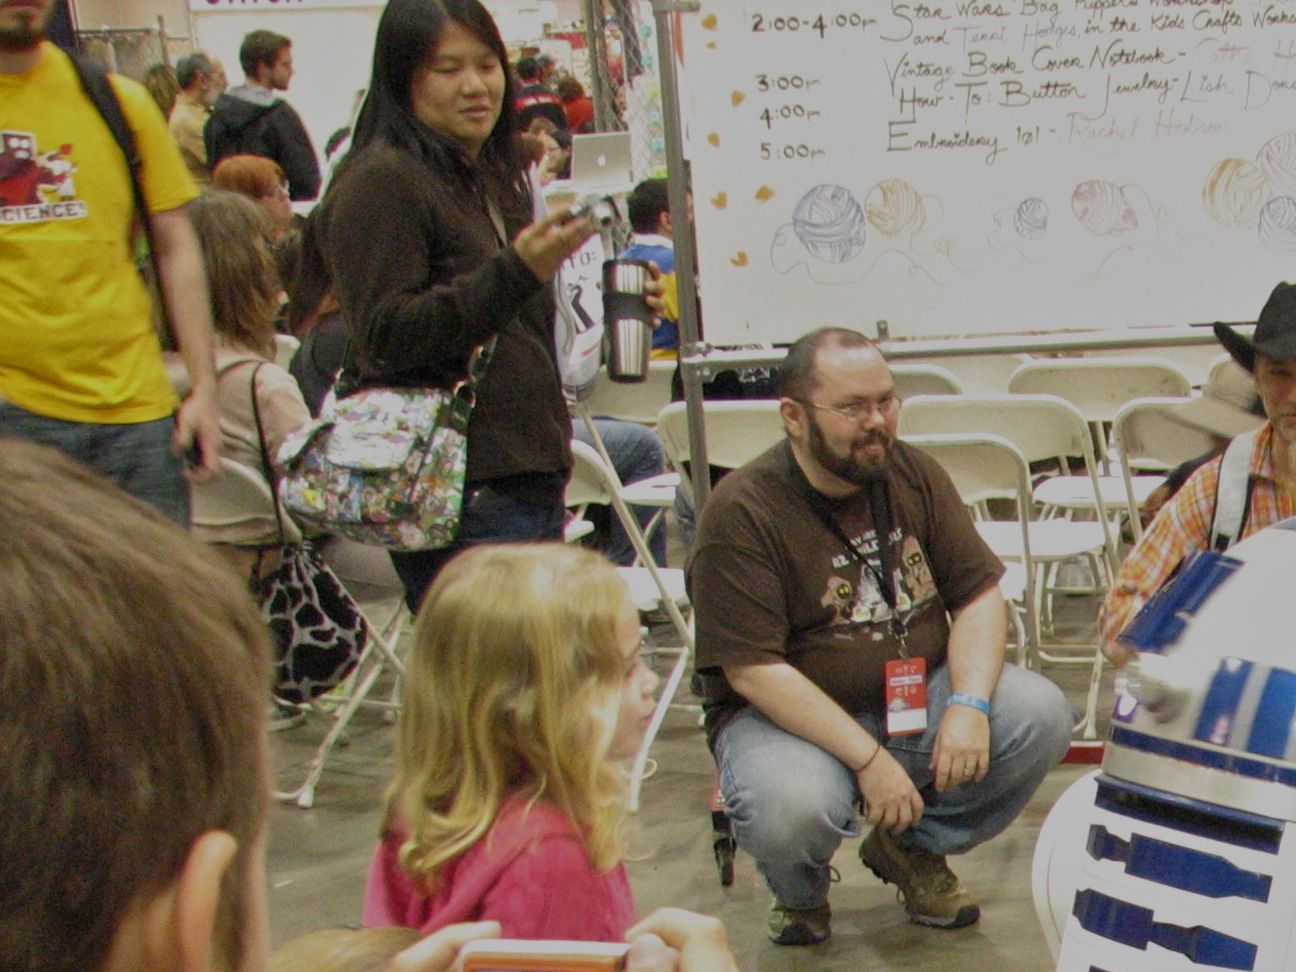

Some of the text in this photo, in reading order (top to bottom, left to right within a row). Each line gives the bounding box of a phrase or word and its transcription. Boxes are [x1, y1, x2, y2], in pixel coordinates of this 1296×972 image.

[880, 4, 951, 41] Star
[913, 30, 949, 45] and
[1084, 20, 1104, 34] in
[1109, 15, 1141, 34] the
[1151, 13, 1185, 31] Kids
[1192, 10, 1243, 34] Crafts
[885, 52, 954, 97] Vintage
[962, 51, 1025, 77] Book
[1031, 46, 1085, 71] Cover
[999, 80, 1086, 107] Button
[887, 120, 1008, 165] Embroidery
[0, 202, 86, 221] CIENCE!
